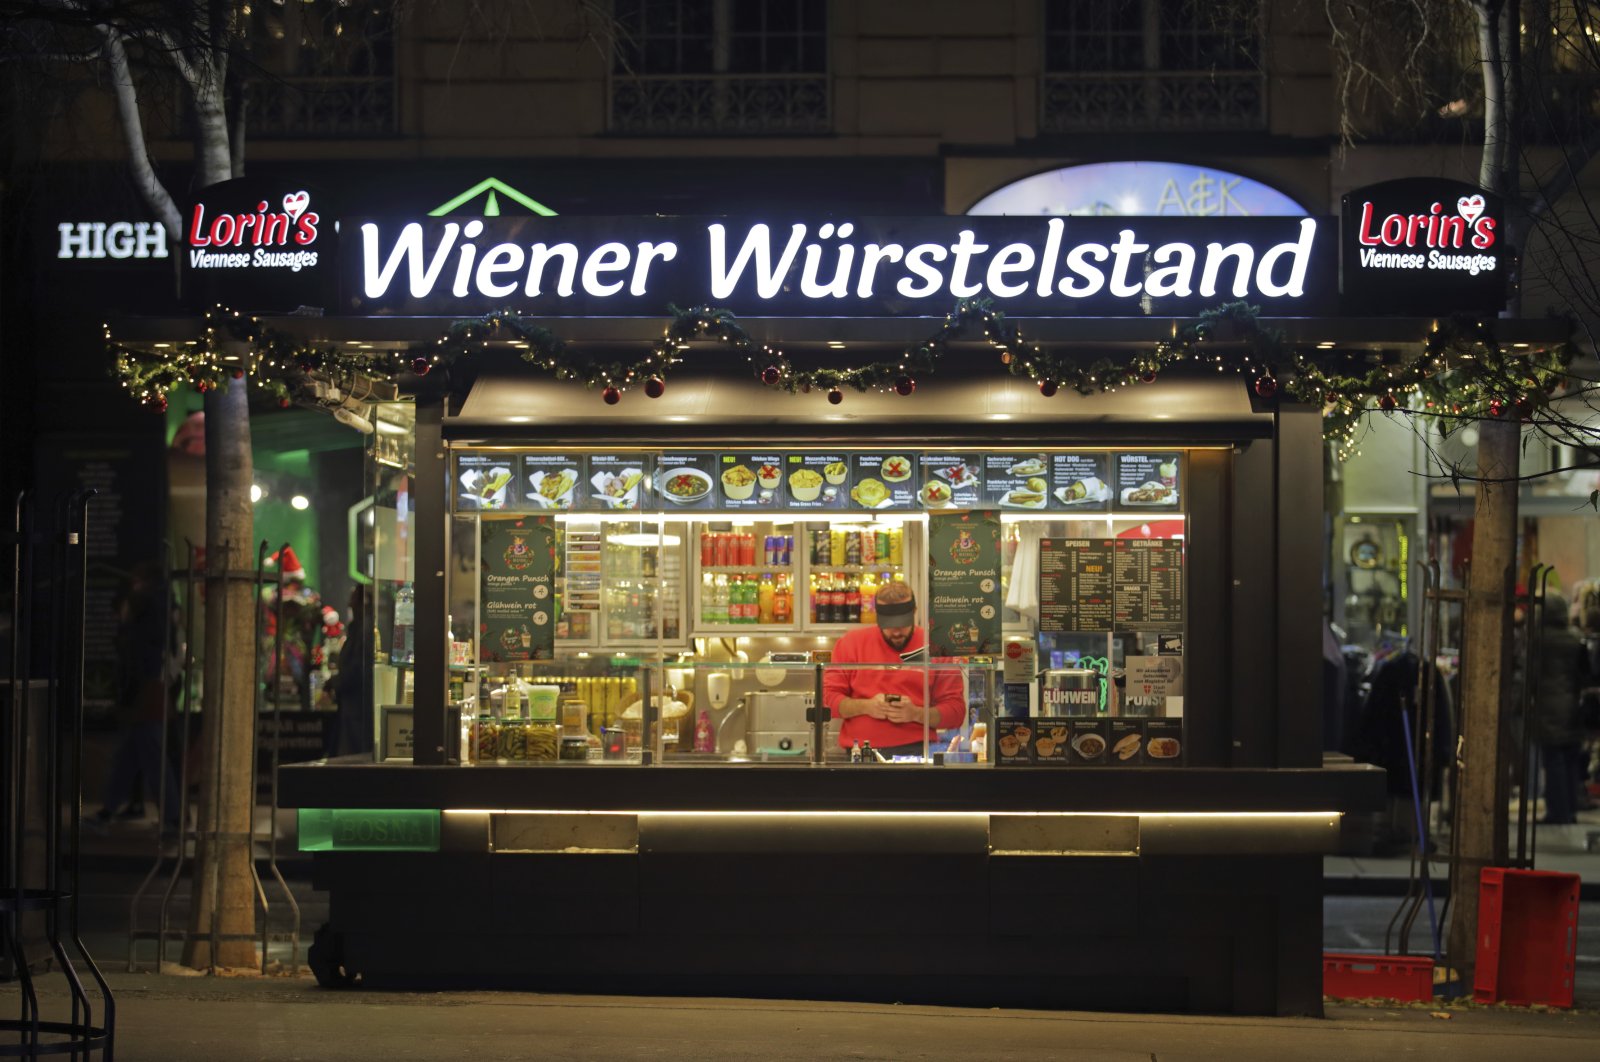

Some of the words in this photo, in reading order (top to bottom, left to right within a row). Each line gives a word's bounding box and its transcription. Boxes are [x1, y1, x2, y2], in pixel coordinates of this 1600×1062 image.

[189, 191, 319, 247] Lorin's
[1359, 195, 1496, 249] Lorin's
[58, 221, 168, 259] HIGH
[190, 249, 250, 268] Viennese
[253, 248, 318, 272] Sausages
[361, 219, 677, 299] Wiener
[708, 217, 1317, 299] Würstelstand
[1360, 248, 1425, 268] Viennese
[1428, 250, 1496, 276] Sausages
[1054, 455, 1067, 463] HOT
[1067, 455, 1080, 463] DOG
[1120, 455, 1148, 463] WÜRSTEL
[1065, 540, 1090, 548] SPEISEN
[1132, 538, 1163, 547] GETRÄNKE
[487, 574, 520, 584] Orangen
[522, 574, 549, 582] Punsch
[934, 569, 966, 577] Orangen
[969, 568, 996, 577] Punsch
[487, 601, 522, 609] Glühwein
[934, 595, 969, 605] Glühwein
[1043, 688, 1097, 704] GLÜHWEIN
[340, 818, 426, 842] BOSNA
